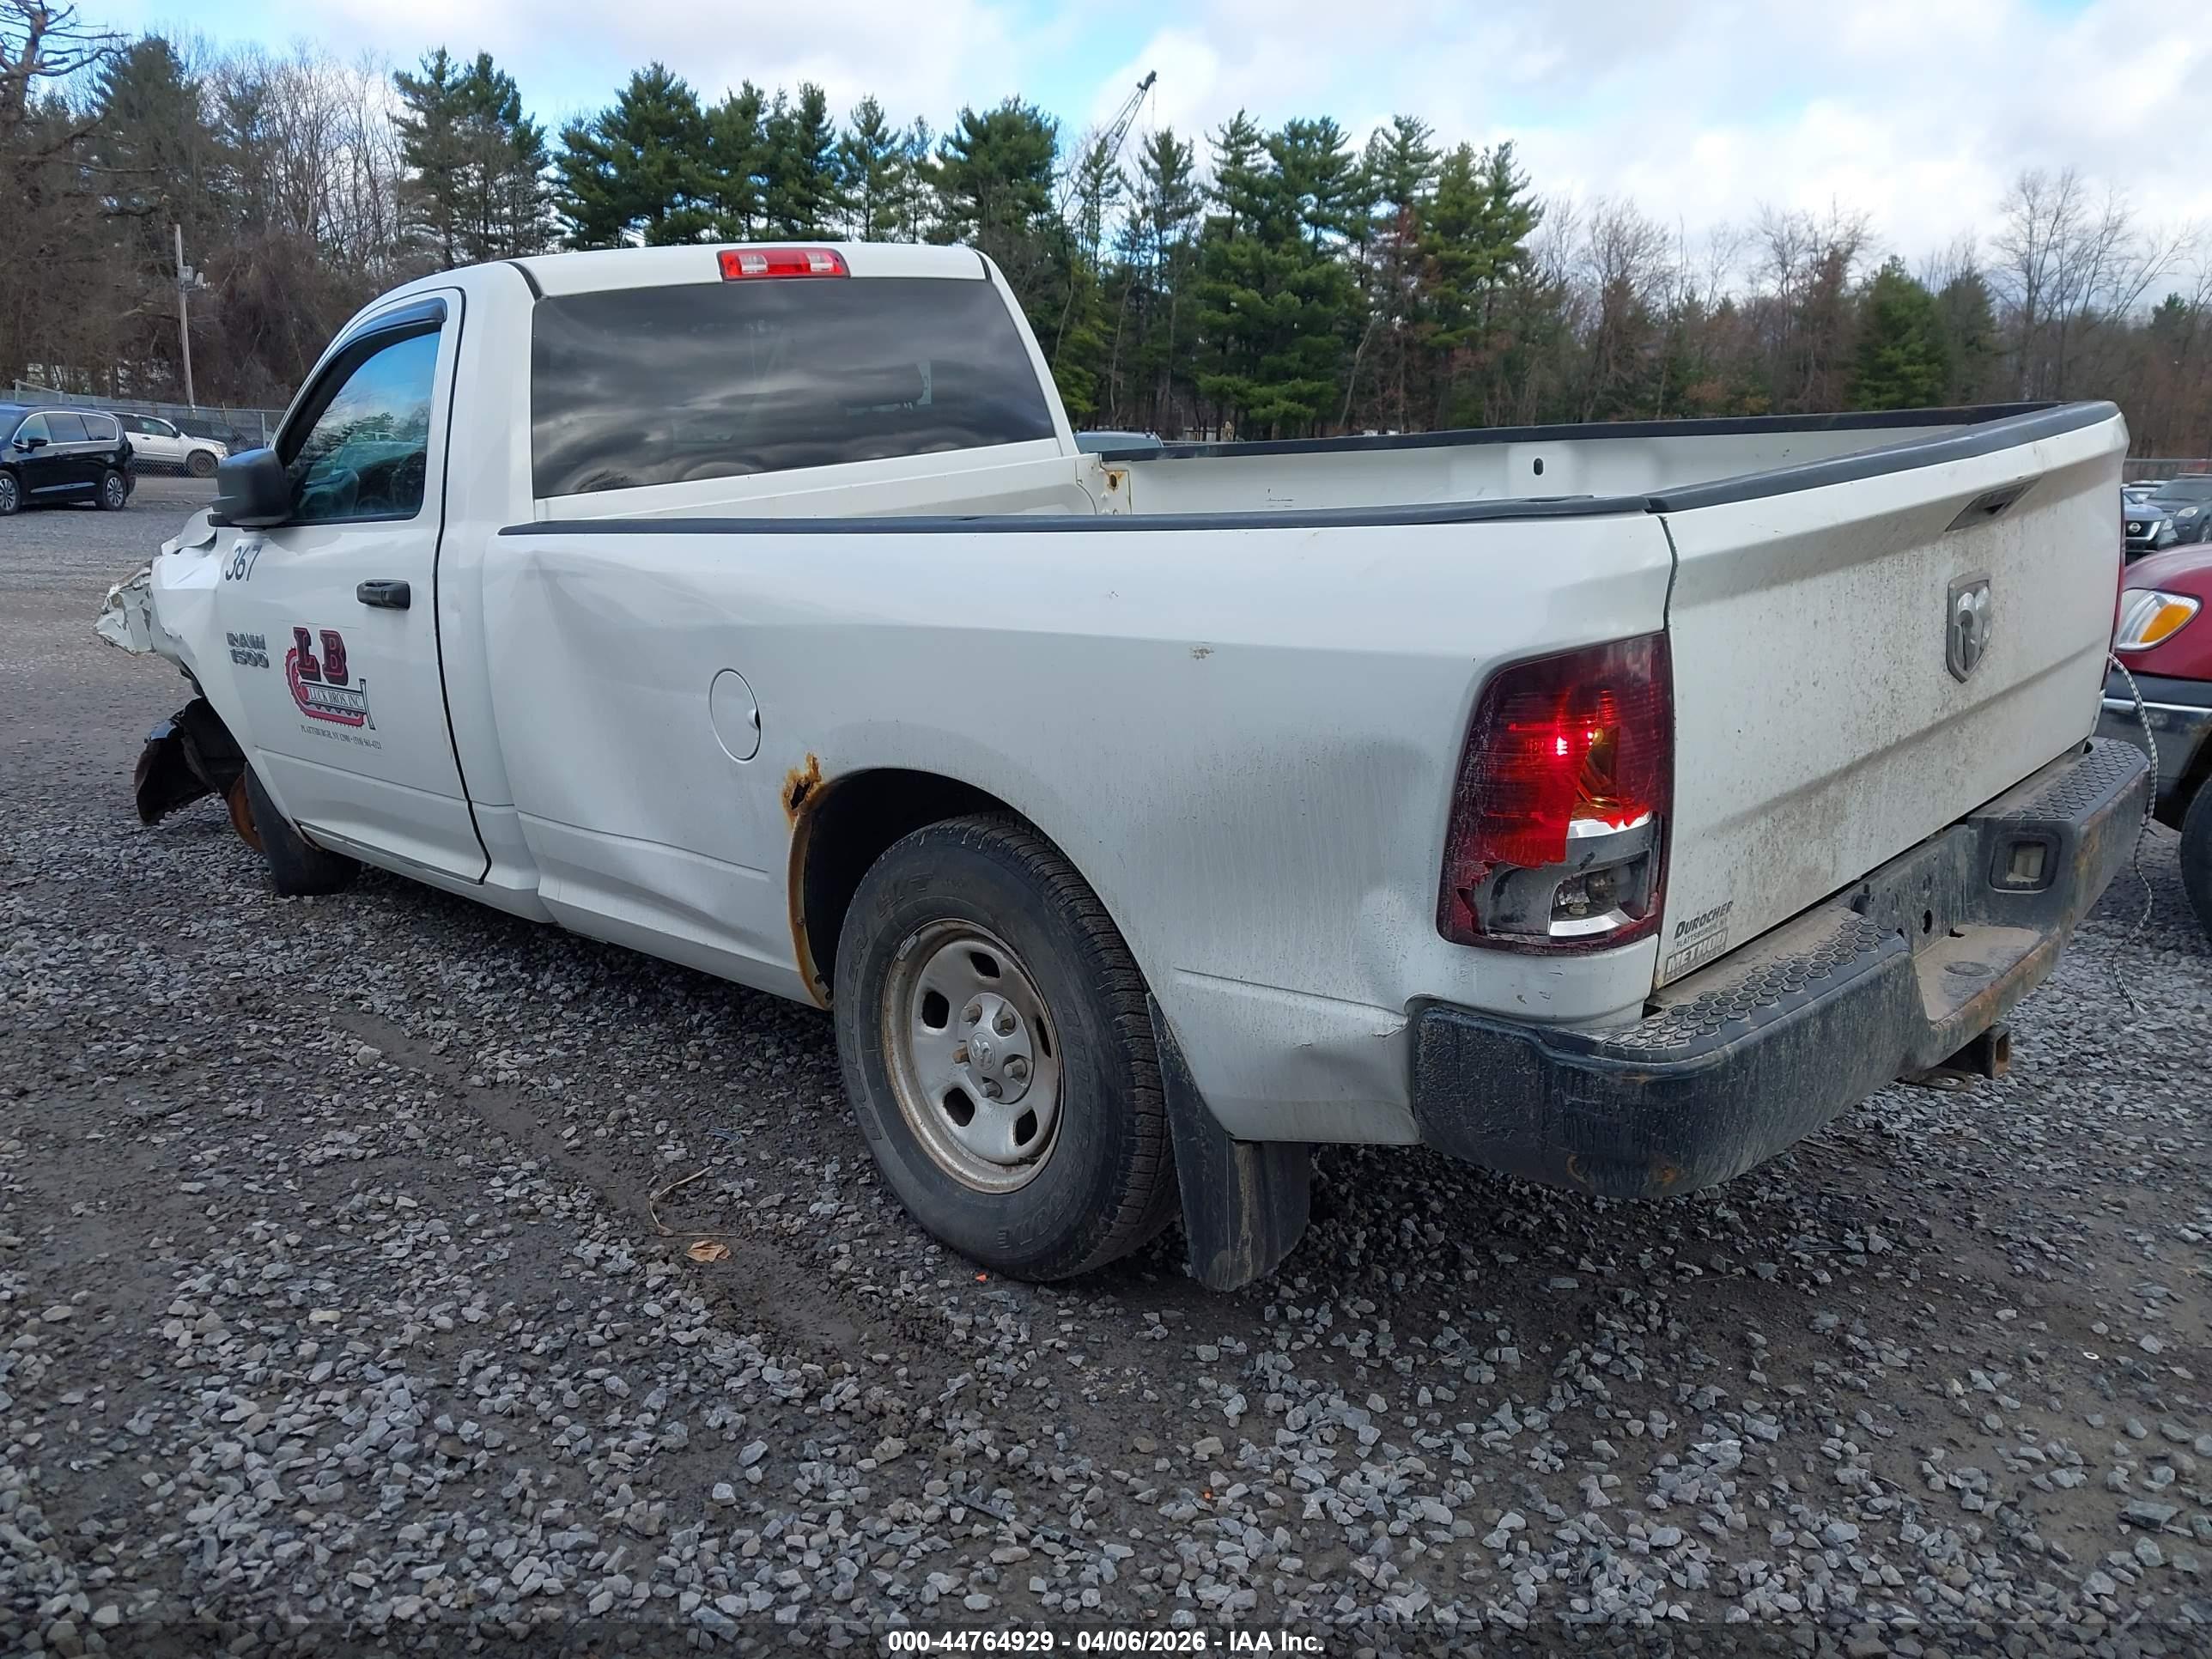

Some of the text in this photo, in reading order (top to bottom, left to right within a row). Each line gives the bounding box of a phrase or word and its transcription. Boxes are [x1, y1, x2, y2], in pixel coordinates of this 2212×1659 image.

[225, 544, 263, 581] 367
[227, 632, 266, 650] RAM
[229, 648, 270, 669] 1500
[308, 687, 329, 702] LUCK
[348, 695, 364, 709] INC.
[1674, 900, 1734, 939] DUROCHER
[1667, 931, 1726, 974] METHOD
